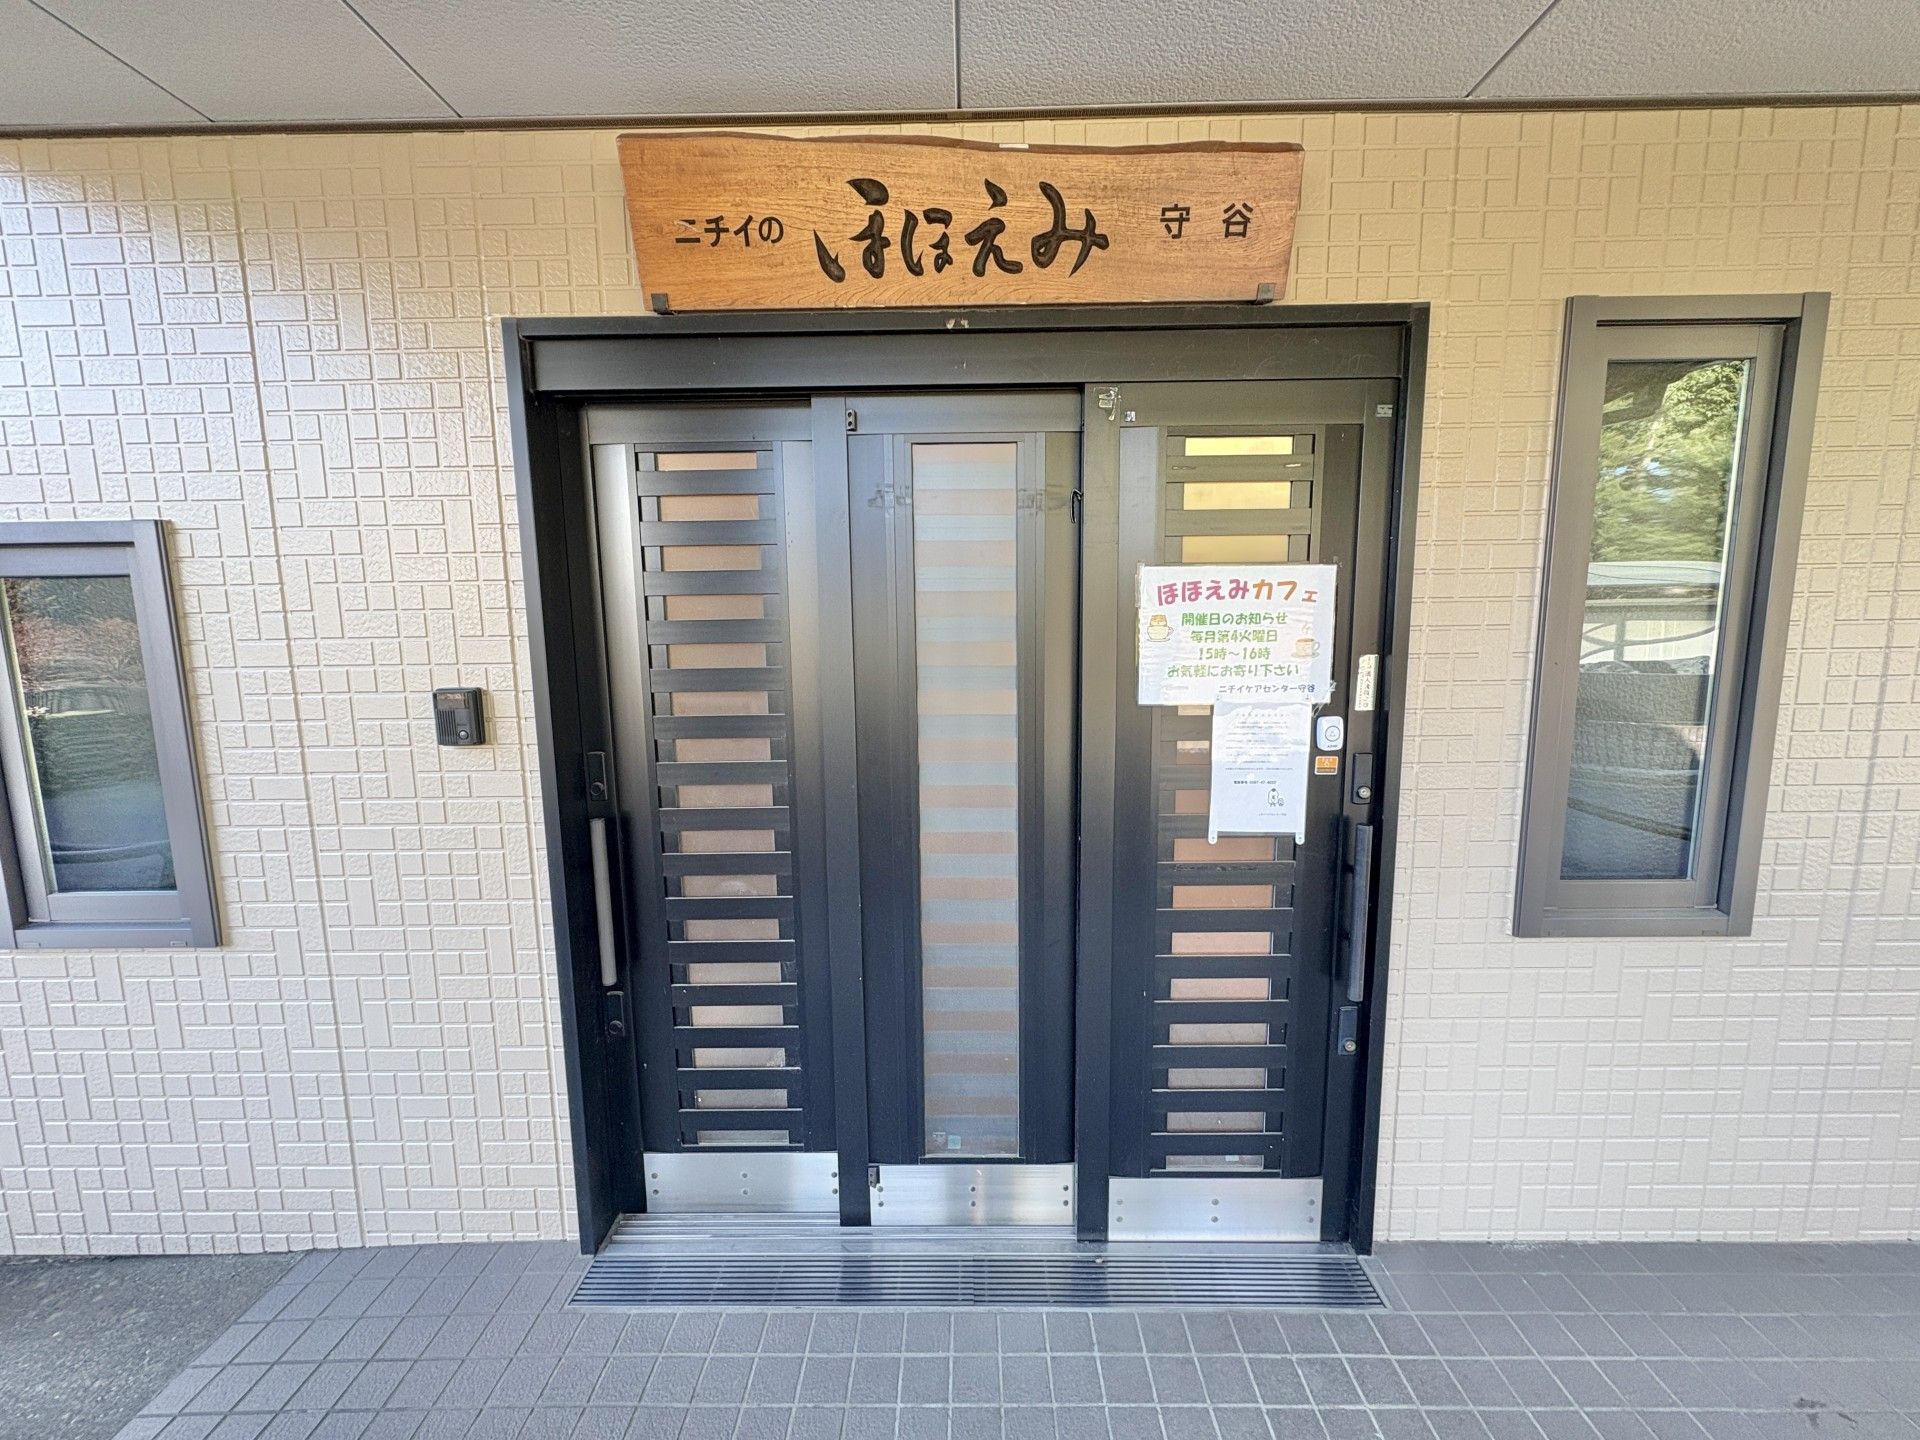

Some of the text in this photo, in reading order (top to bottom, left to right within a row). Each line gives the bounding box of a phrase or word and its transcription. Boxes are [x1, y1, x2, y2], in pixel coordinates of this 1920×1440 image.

[675, 177, 1254, 284] ニチイの ほほえみ 守谷
[1157, 578, 1319, 606] ほほえみカフェ
[1181, 612, 1289, 626] 開催日のお知らせ
[1190, 629, 1278, 643] 毎月第4火曜日
[1167, 664, 1299, 678] お気軽にお寄り下さい
[1218, 683, 1316, 694] ニチイケアセンター守谷
